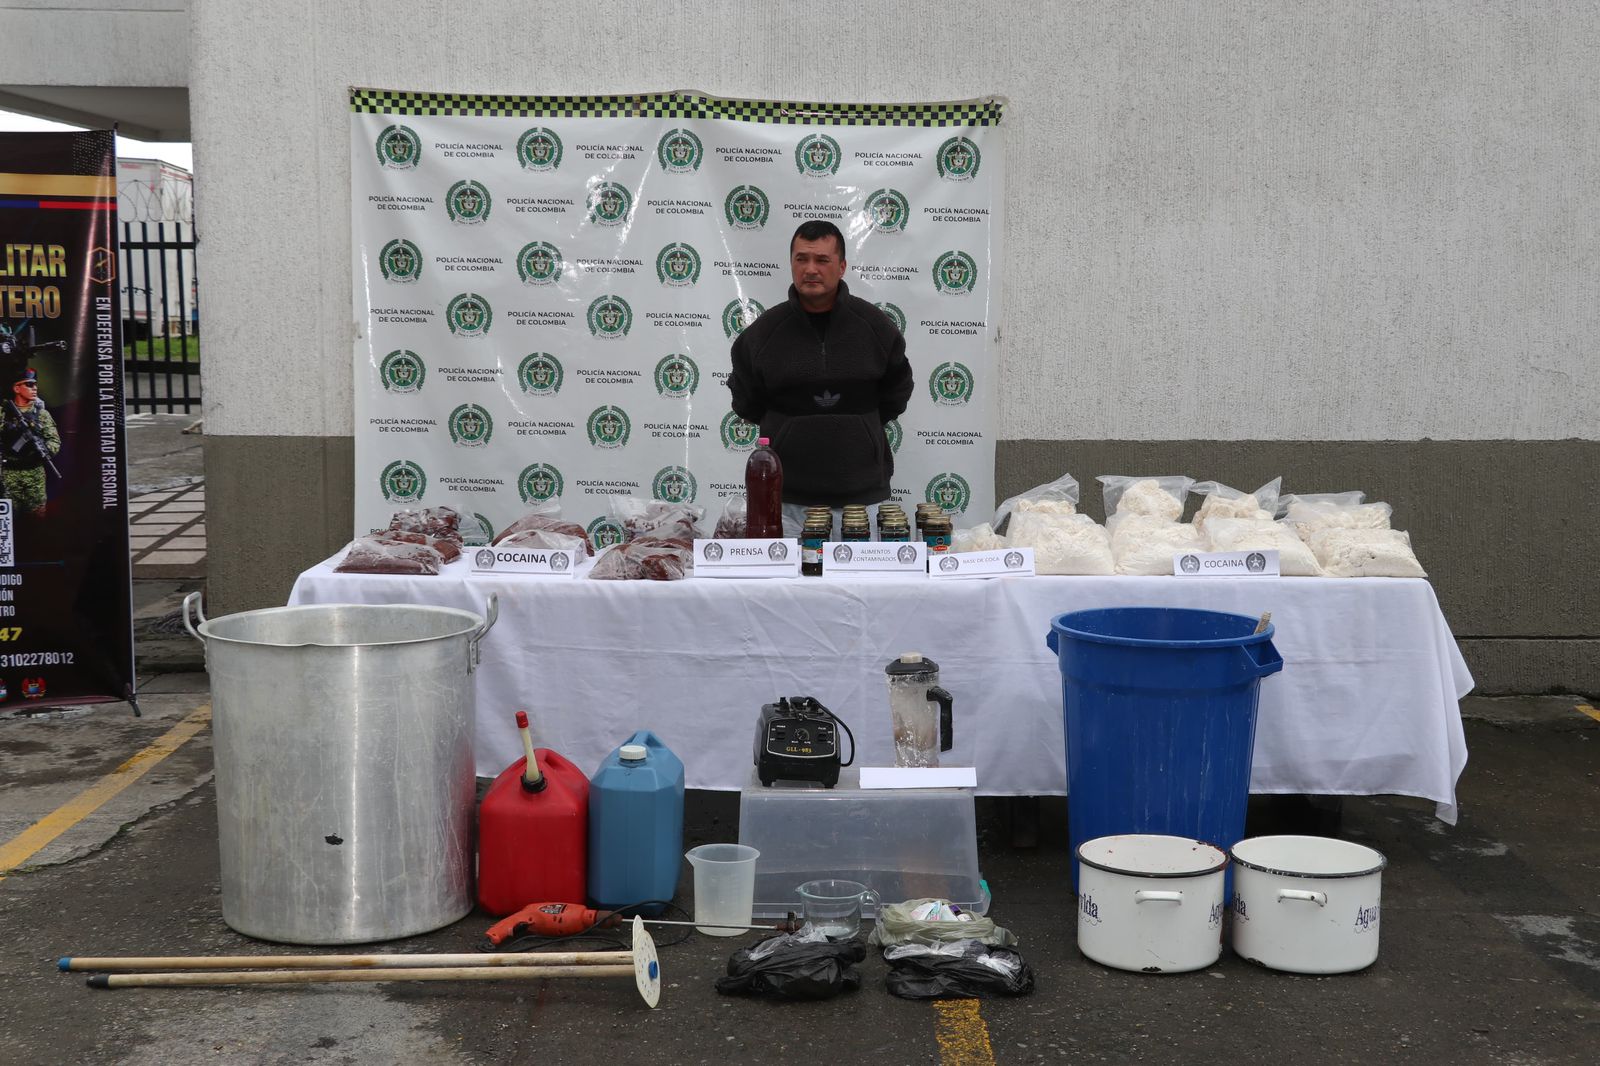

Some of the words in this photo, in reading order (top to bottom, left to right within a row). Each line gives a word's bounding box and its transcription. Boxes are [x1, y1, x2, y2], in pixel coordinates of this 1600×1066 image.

[96, 297, 111, 310] EN
[96, 314, 112, 360] DEFENSA
[98, 364, 114, 384] POR
[99, 388, 114, 401] LA
[100, 404, 116, 452] LIBERTAD
[102, 456, 117, 509] PERSONAL
[497, 552, 546, 564] COCAINA
[730, 548, 763, 556] PRENSA
[1204, 559, 1244, 568] COCAINA
[0, 652, 74, 668] 3102278012
